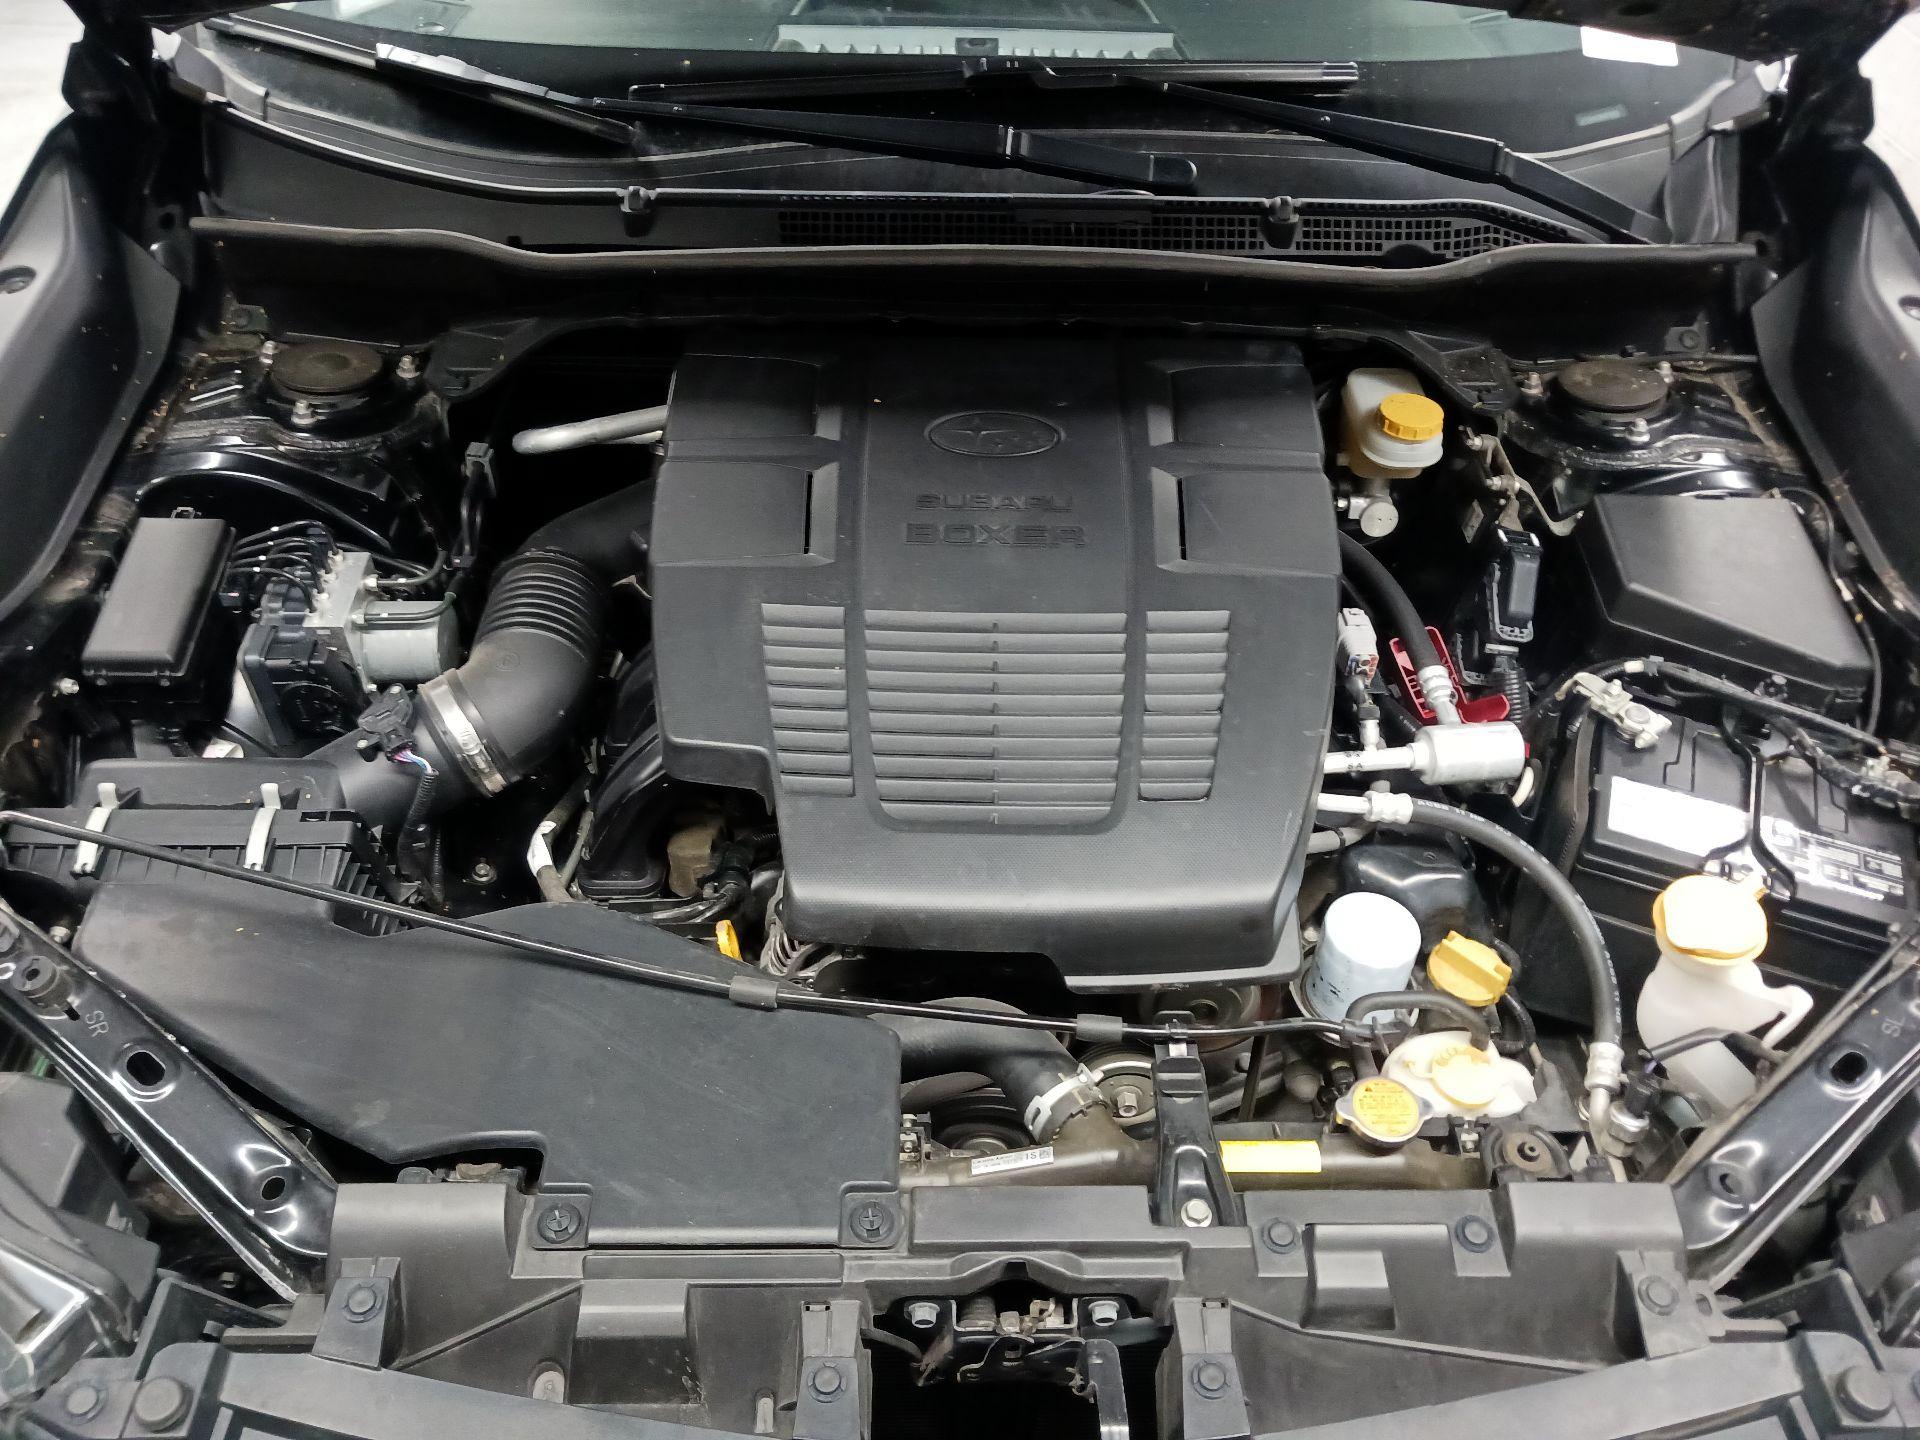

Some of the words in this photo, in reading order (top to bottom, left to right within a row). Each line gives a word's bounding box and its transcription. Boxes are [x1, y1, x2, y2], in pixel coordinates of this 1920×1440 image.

[915, 494, 1073, 511] SUBARU
[905, 522, 1086, 546] BOXER
[85, 1010, 110, 1037] SR
